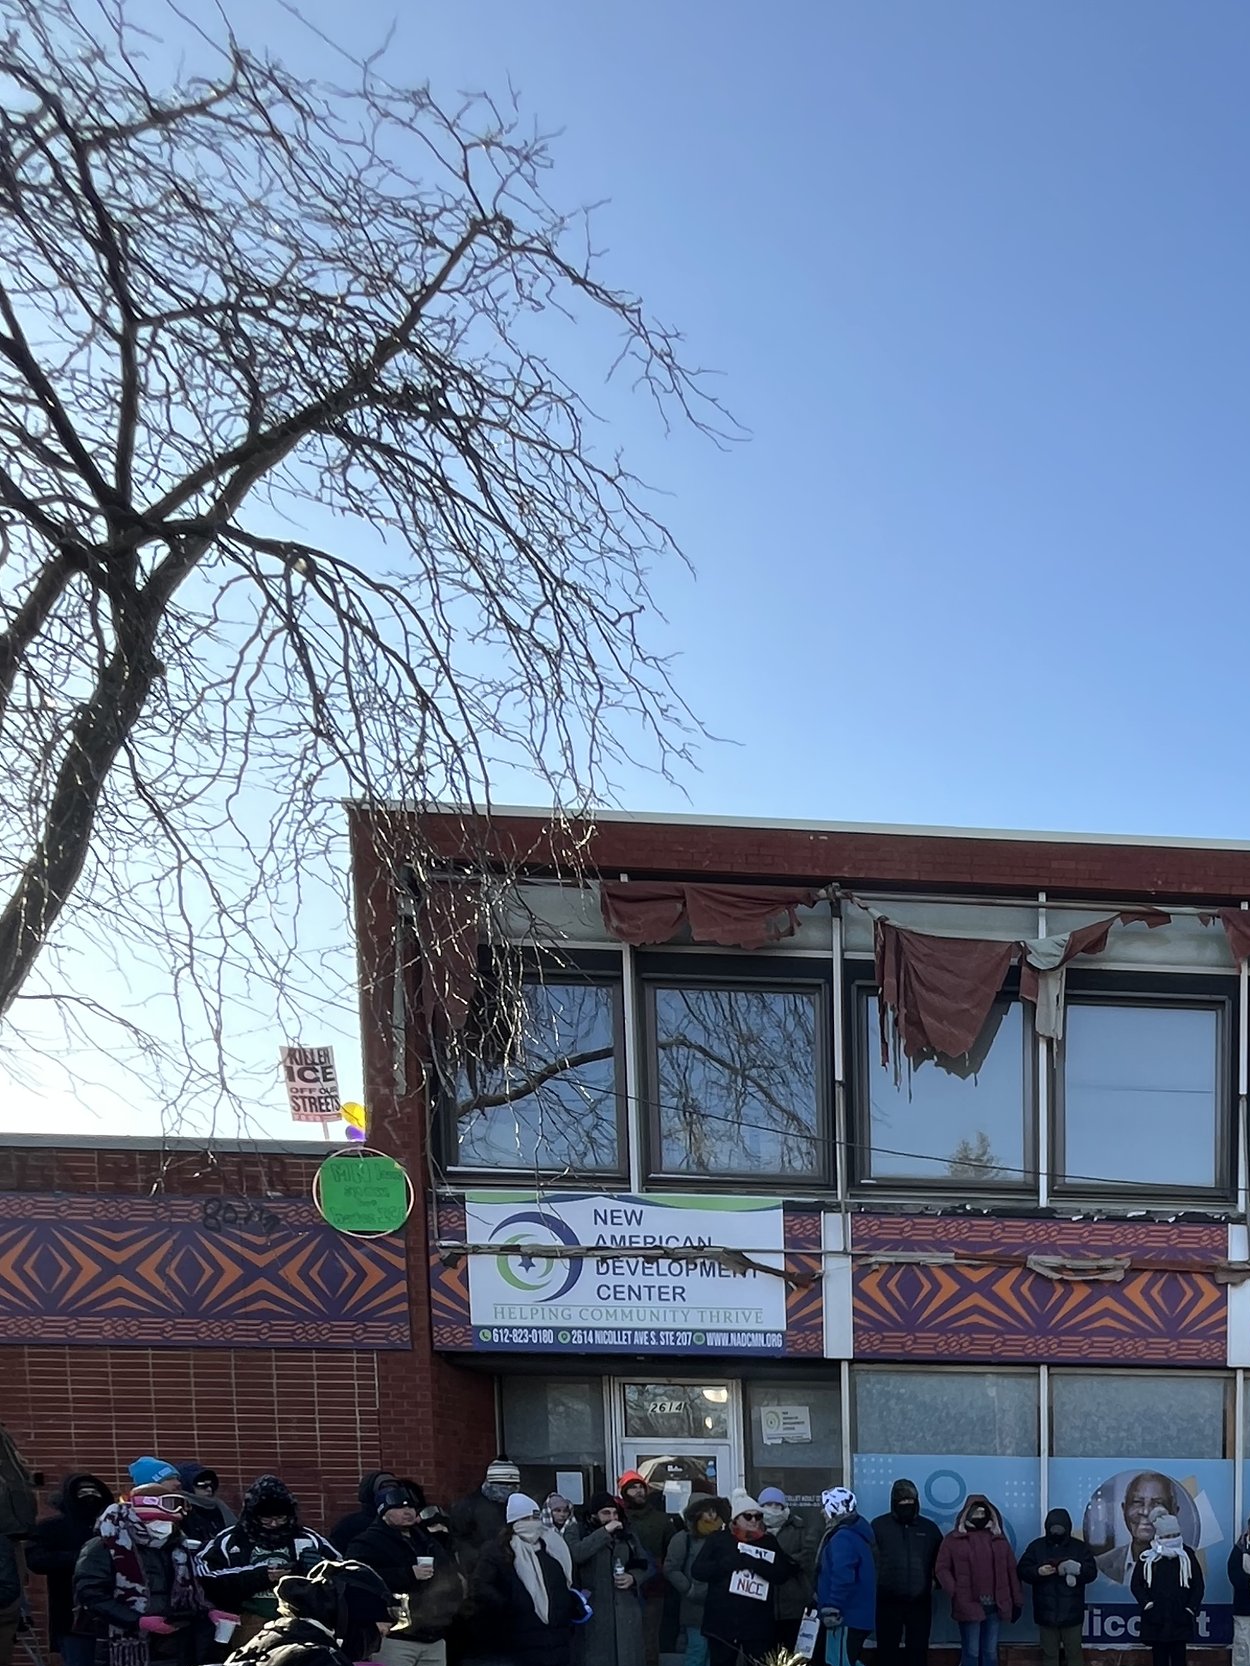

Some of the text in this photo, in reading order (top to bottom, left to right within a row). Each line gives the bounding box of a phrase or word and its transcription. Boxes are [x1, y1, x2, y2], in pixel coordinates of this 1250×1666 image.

[288, 1047, 331, 1066] KILLER
[285, 1065, 336, 1083] ICE
[290, 1087, 317, 1095] OFF
[290, 1095, 341, 1113] STREETS
[594, 1209, 643, 1226] NEW
[595, 1234, 712, 1247] AMERICAN
[596, 1259, 758, 1279] DEVELOPME
[596, 1284, 686, 1302] CENTER
[493, 1306, 763, 1324] HELPING COMMUNITY THRIVE
[492, 1328, 554, 1344] 612-823-0180
[571, 1329, 593, 1344] 2614
[594, 1330, 632, 1345] NICOLLET
[633, 1331, 649, 1345] AVE
[660, 1331, 675, 1346] STE
[676, 1331, 693, 1346] 207
[650, 1402, 683, 1413] 2614
[737, 1576, 764, 1597] NICE
